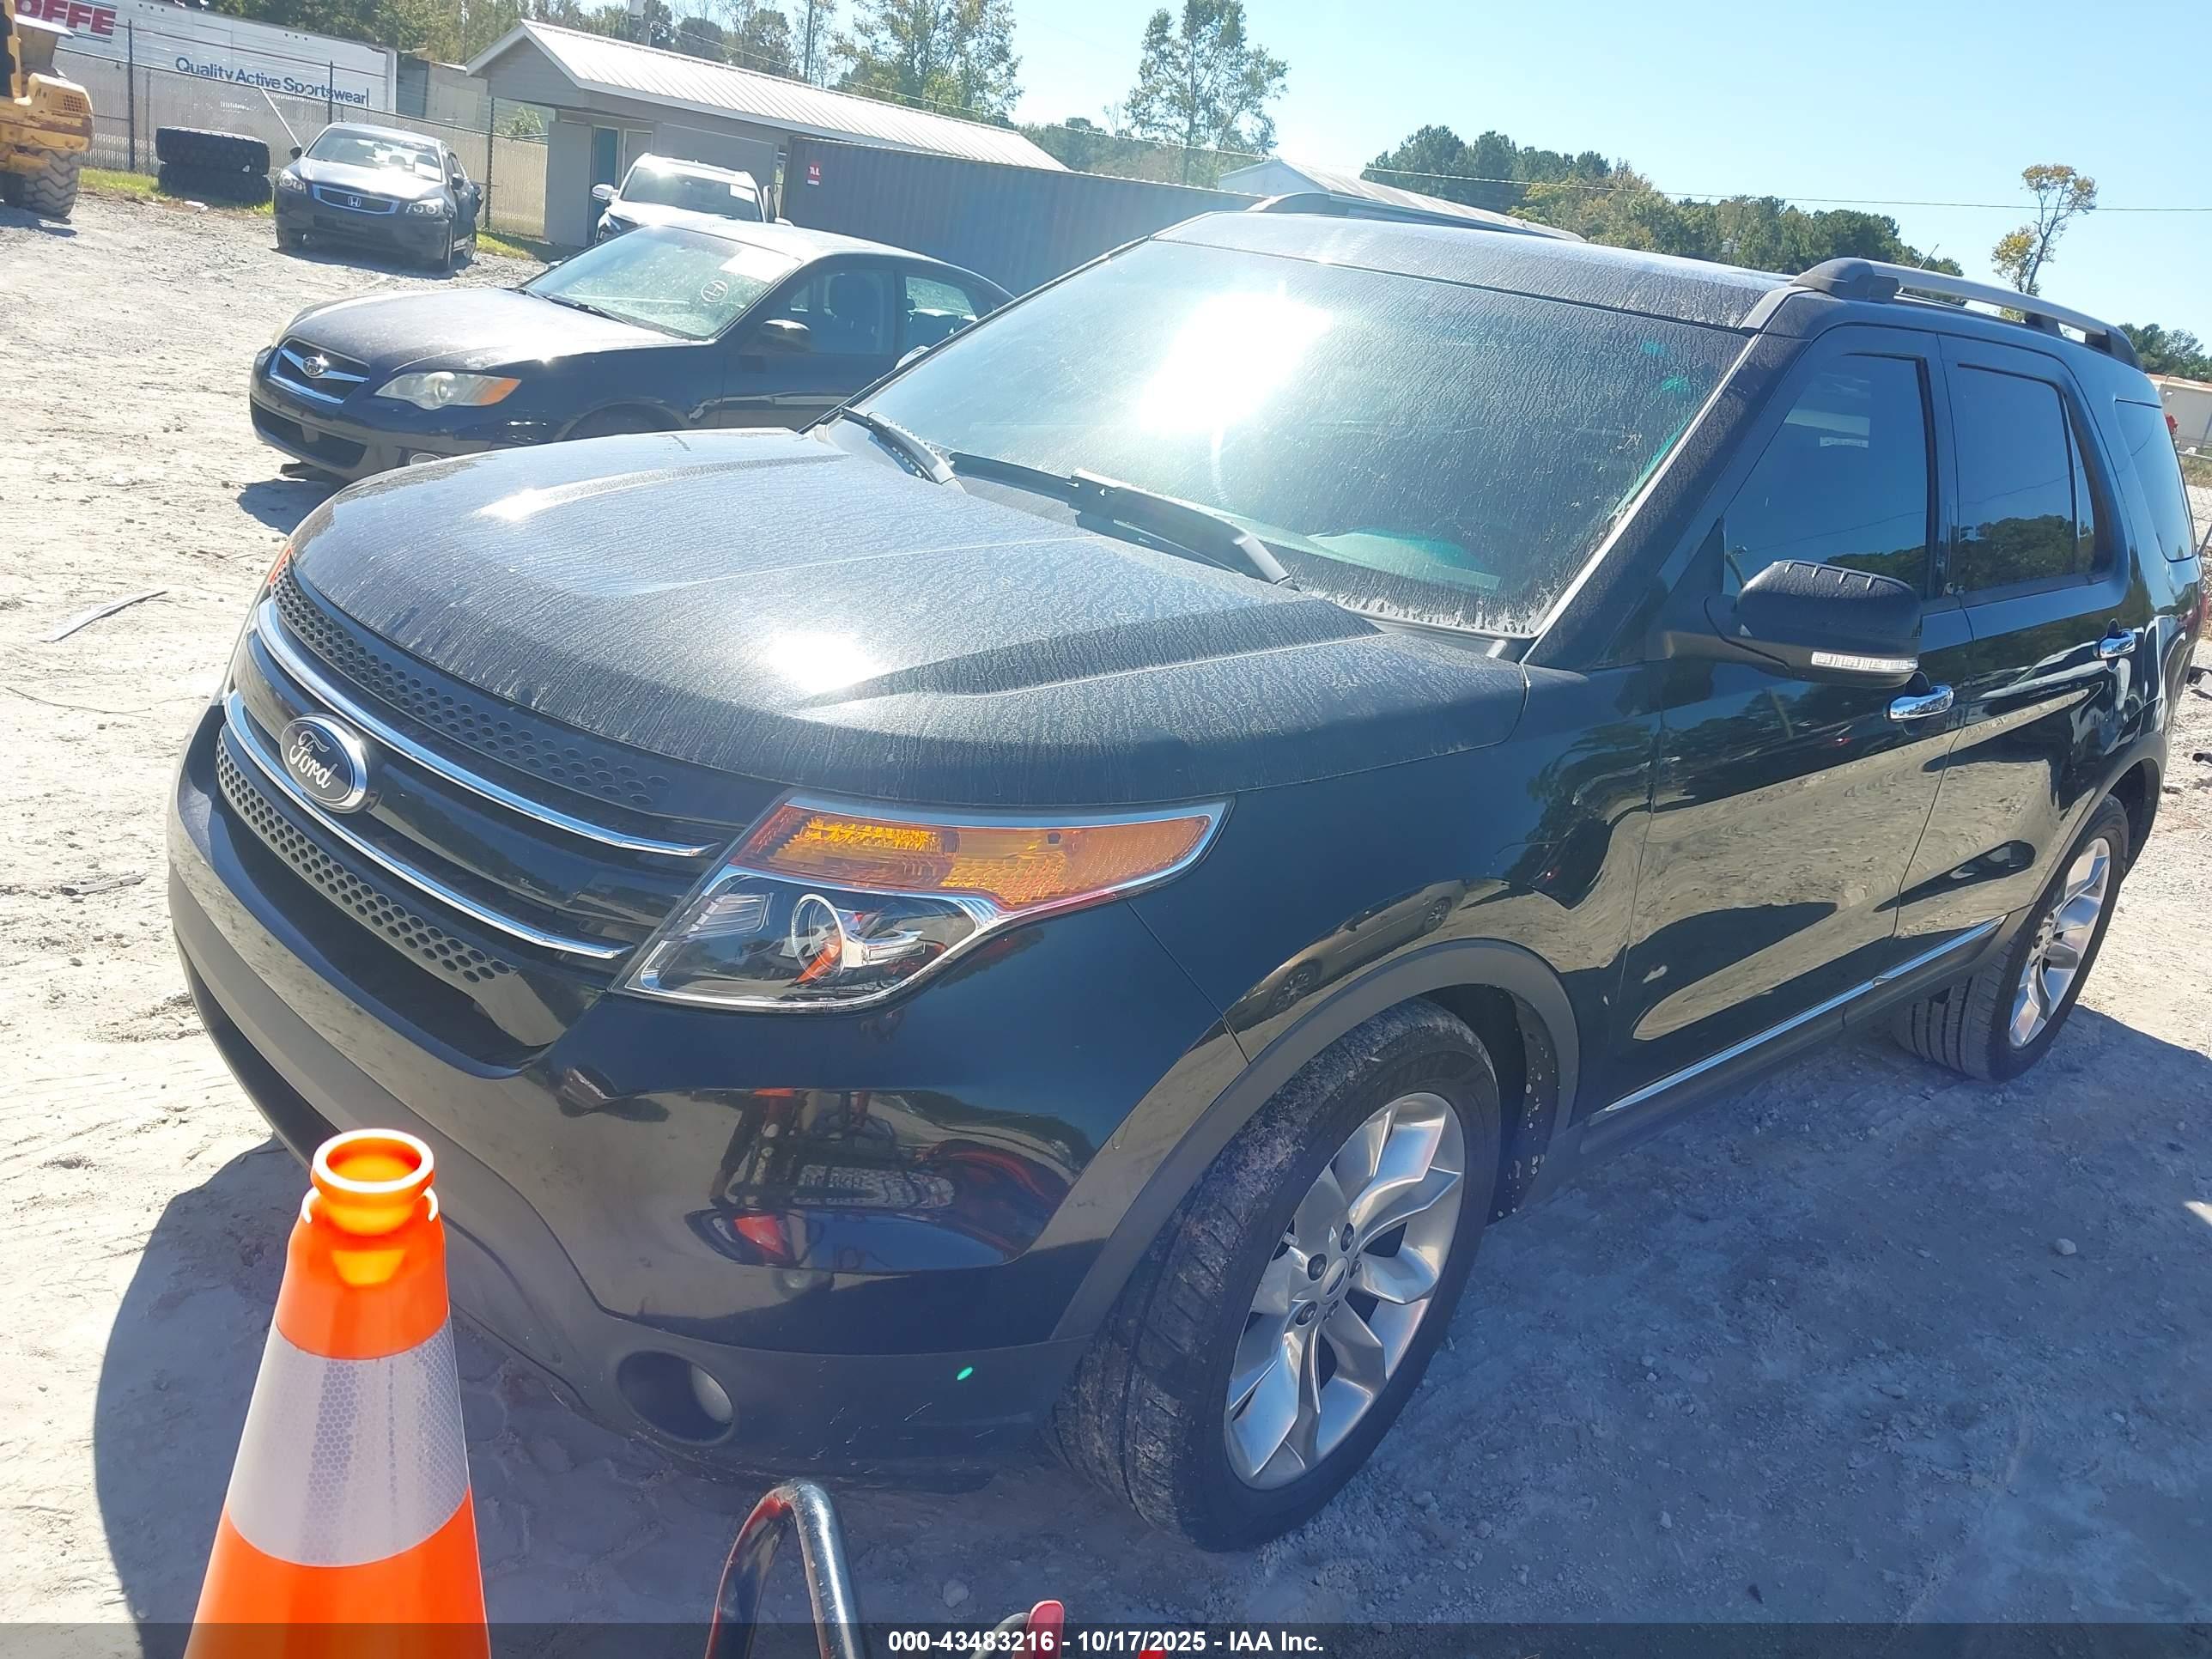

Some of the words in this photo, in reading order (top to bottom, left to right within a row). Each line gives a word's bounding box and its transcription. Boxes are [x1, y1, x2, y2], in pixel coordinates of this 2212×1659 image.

[175, 57, 234, 80] Quality
[235, 68, 281, 88] Active
[283, 76, 366, 105] Sportswear
[289, 730, 338, 789] Ford
